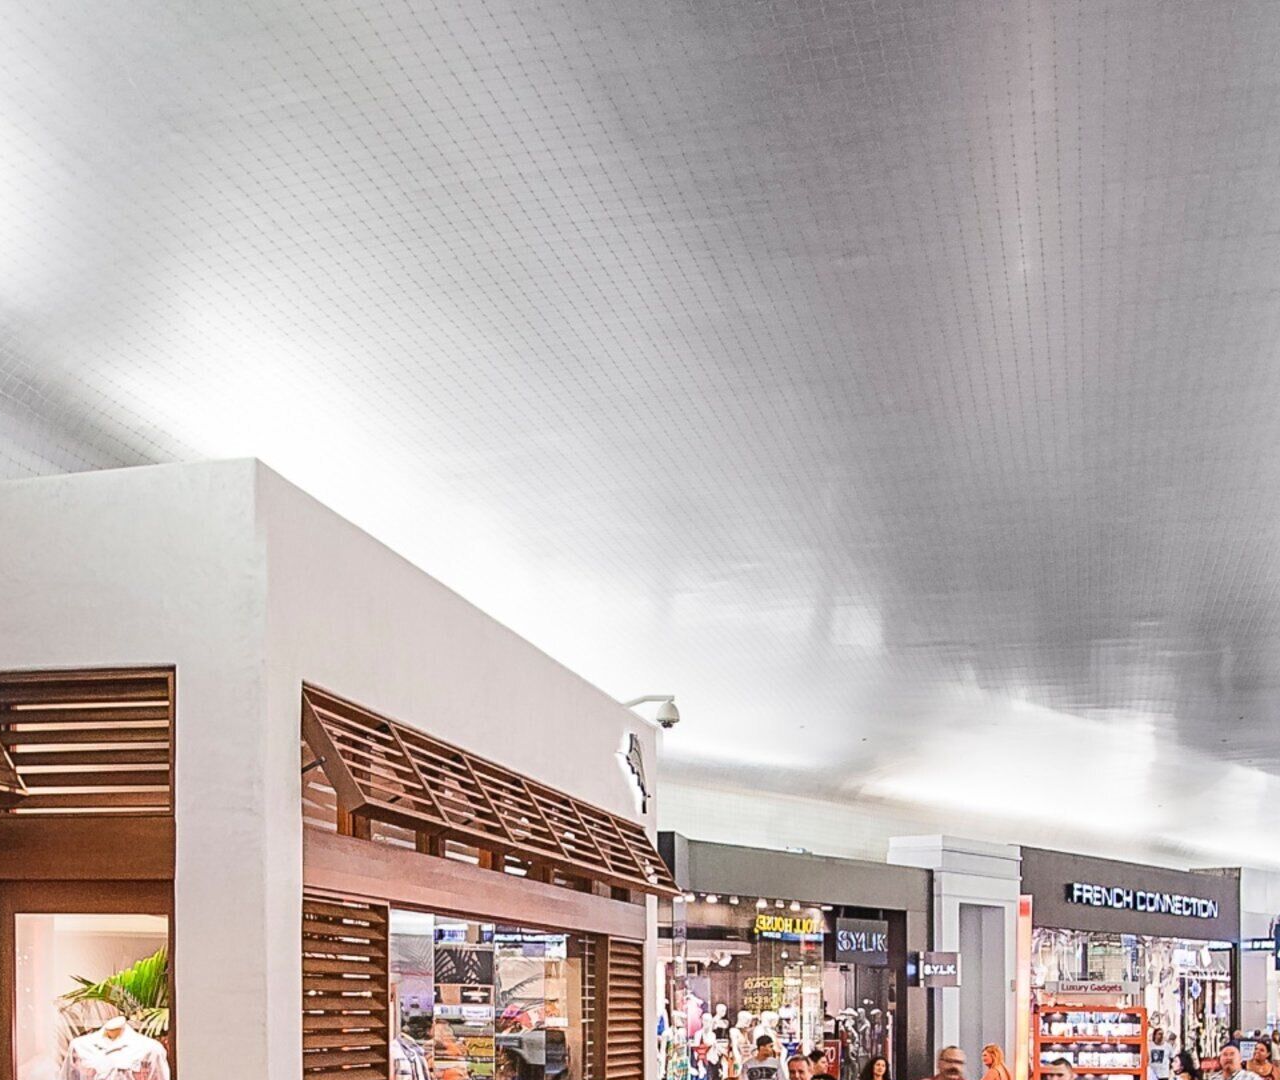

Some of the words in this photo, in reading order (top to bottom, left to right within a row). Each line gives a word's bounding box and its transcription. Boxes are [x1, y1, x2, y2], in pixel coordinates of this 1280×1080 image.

[1073, 882, 1133, 909] FRENCH
[1136, 891, 1218, 918] CONNECTION
[1061, 983, 1088, 992] Luxury
[1090, 983, 1122, 993] Gadgets
